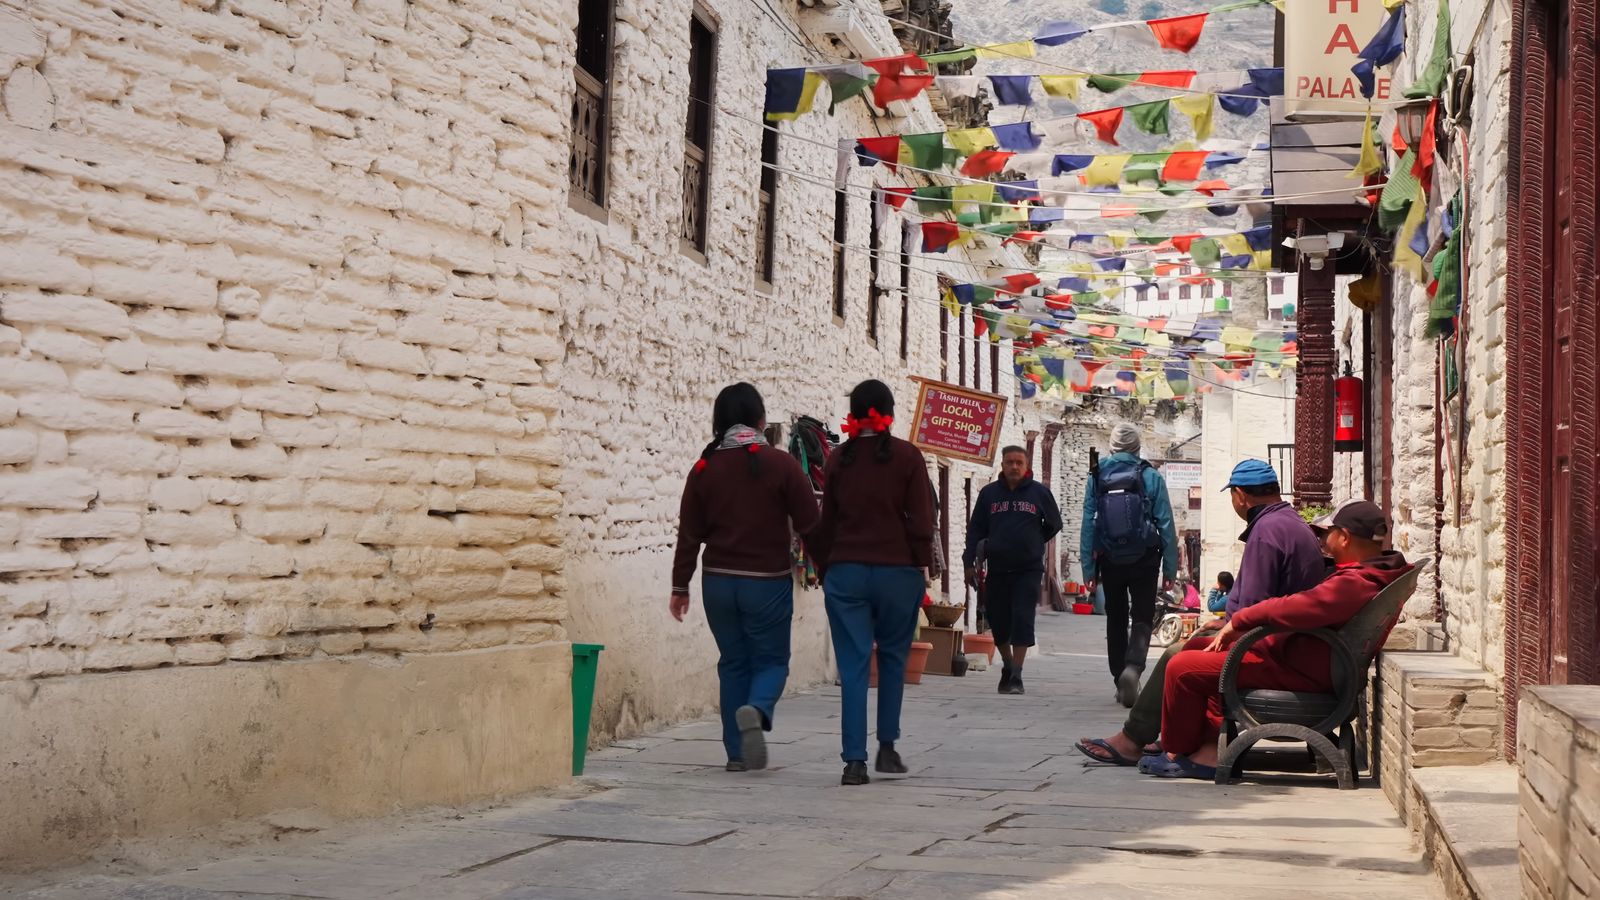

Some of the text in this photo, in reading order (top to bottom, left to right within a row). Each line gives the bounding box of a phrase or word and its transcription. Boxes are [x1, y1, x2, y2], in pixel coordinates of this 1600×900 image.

[1296, 76, 1391, 99] PALAE
[937, 391, 985, 413] TASHI DELEK
[942, 404, 973, 418] LOCAL
[931, 416, 982, 433] GIFT SHOP
